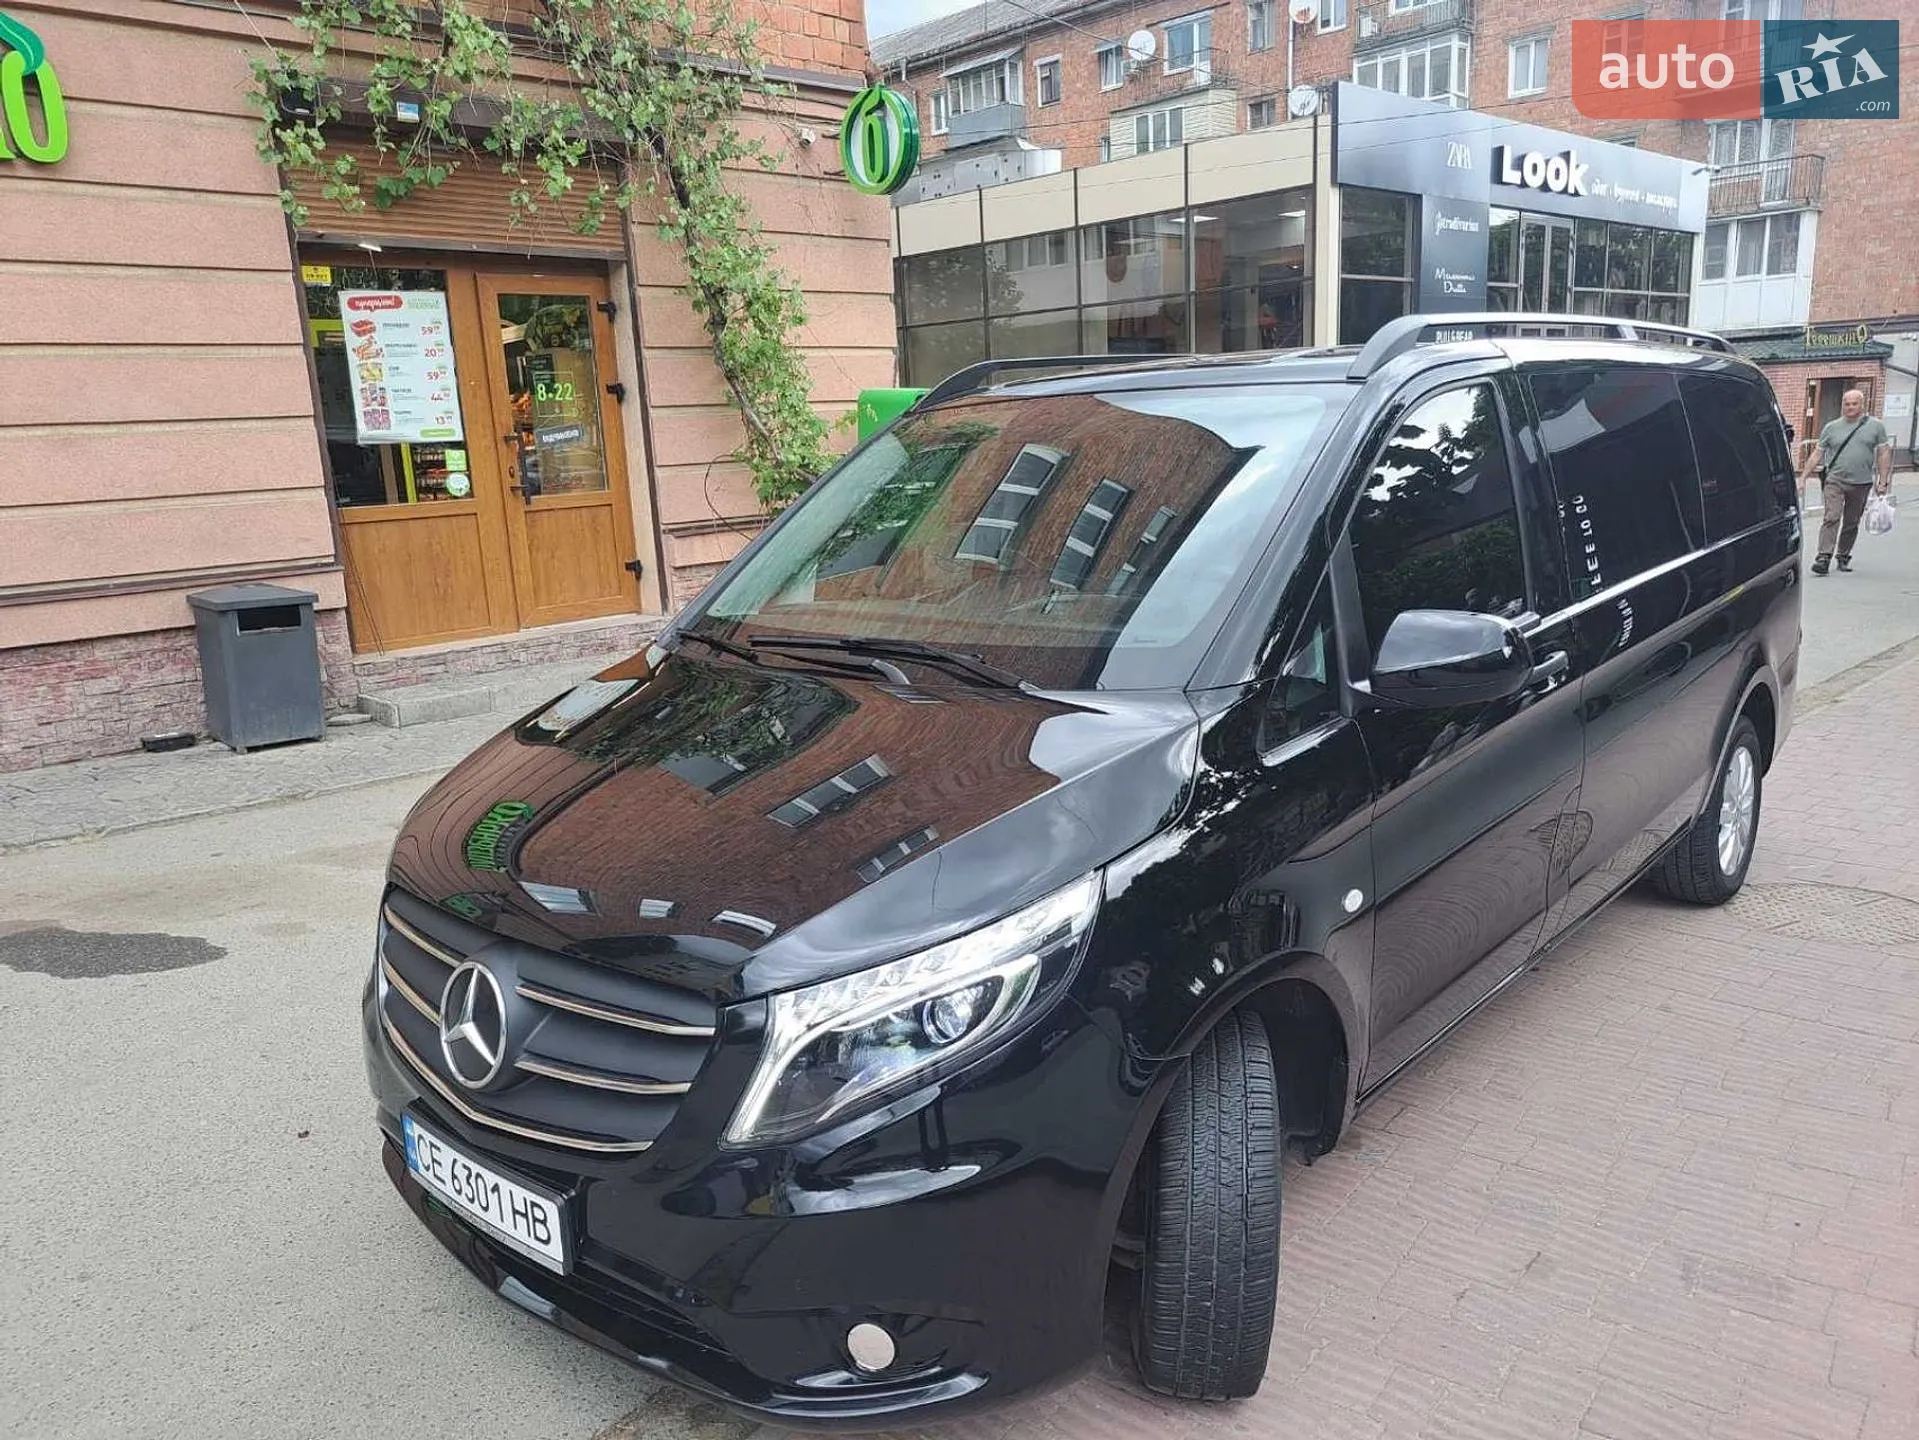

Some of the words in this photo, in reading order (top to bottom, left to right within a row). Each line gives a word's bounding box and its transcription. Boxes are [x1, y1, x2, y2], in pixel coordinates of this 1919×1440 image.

[417, 1133, 447, 1187] CE
[451, 1158, 504, 1224] 6301
[509, 1189, 552, 1246] HB
